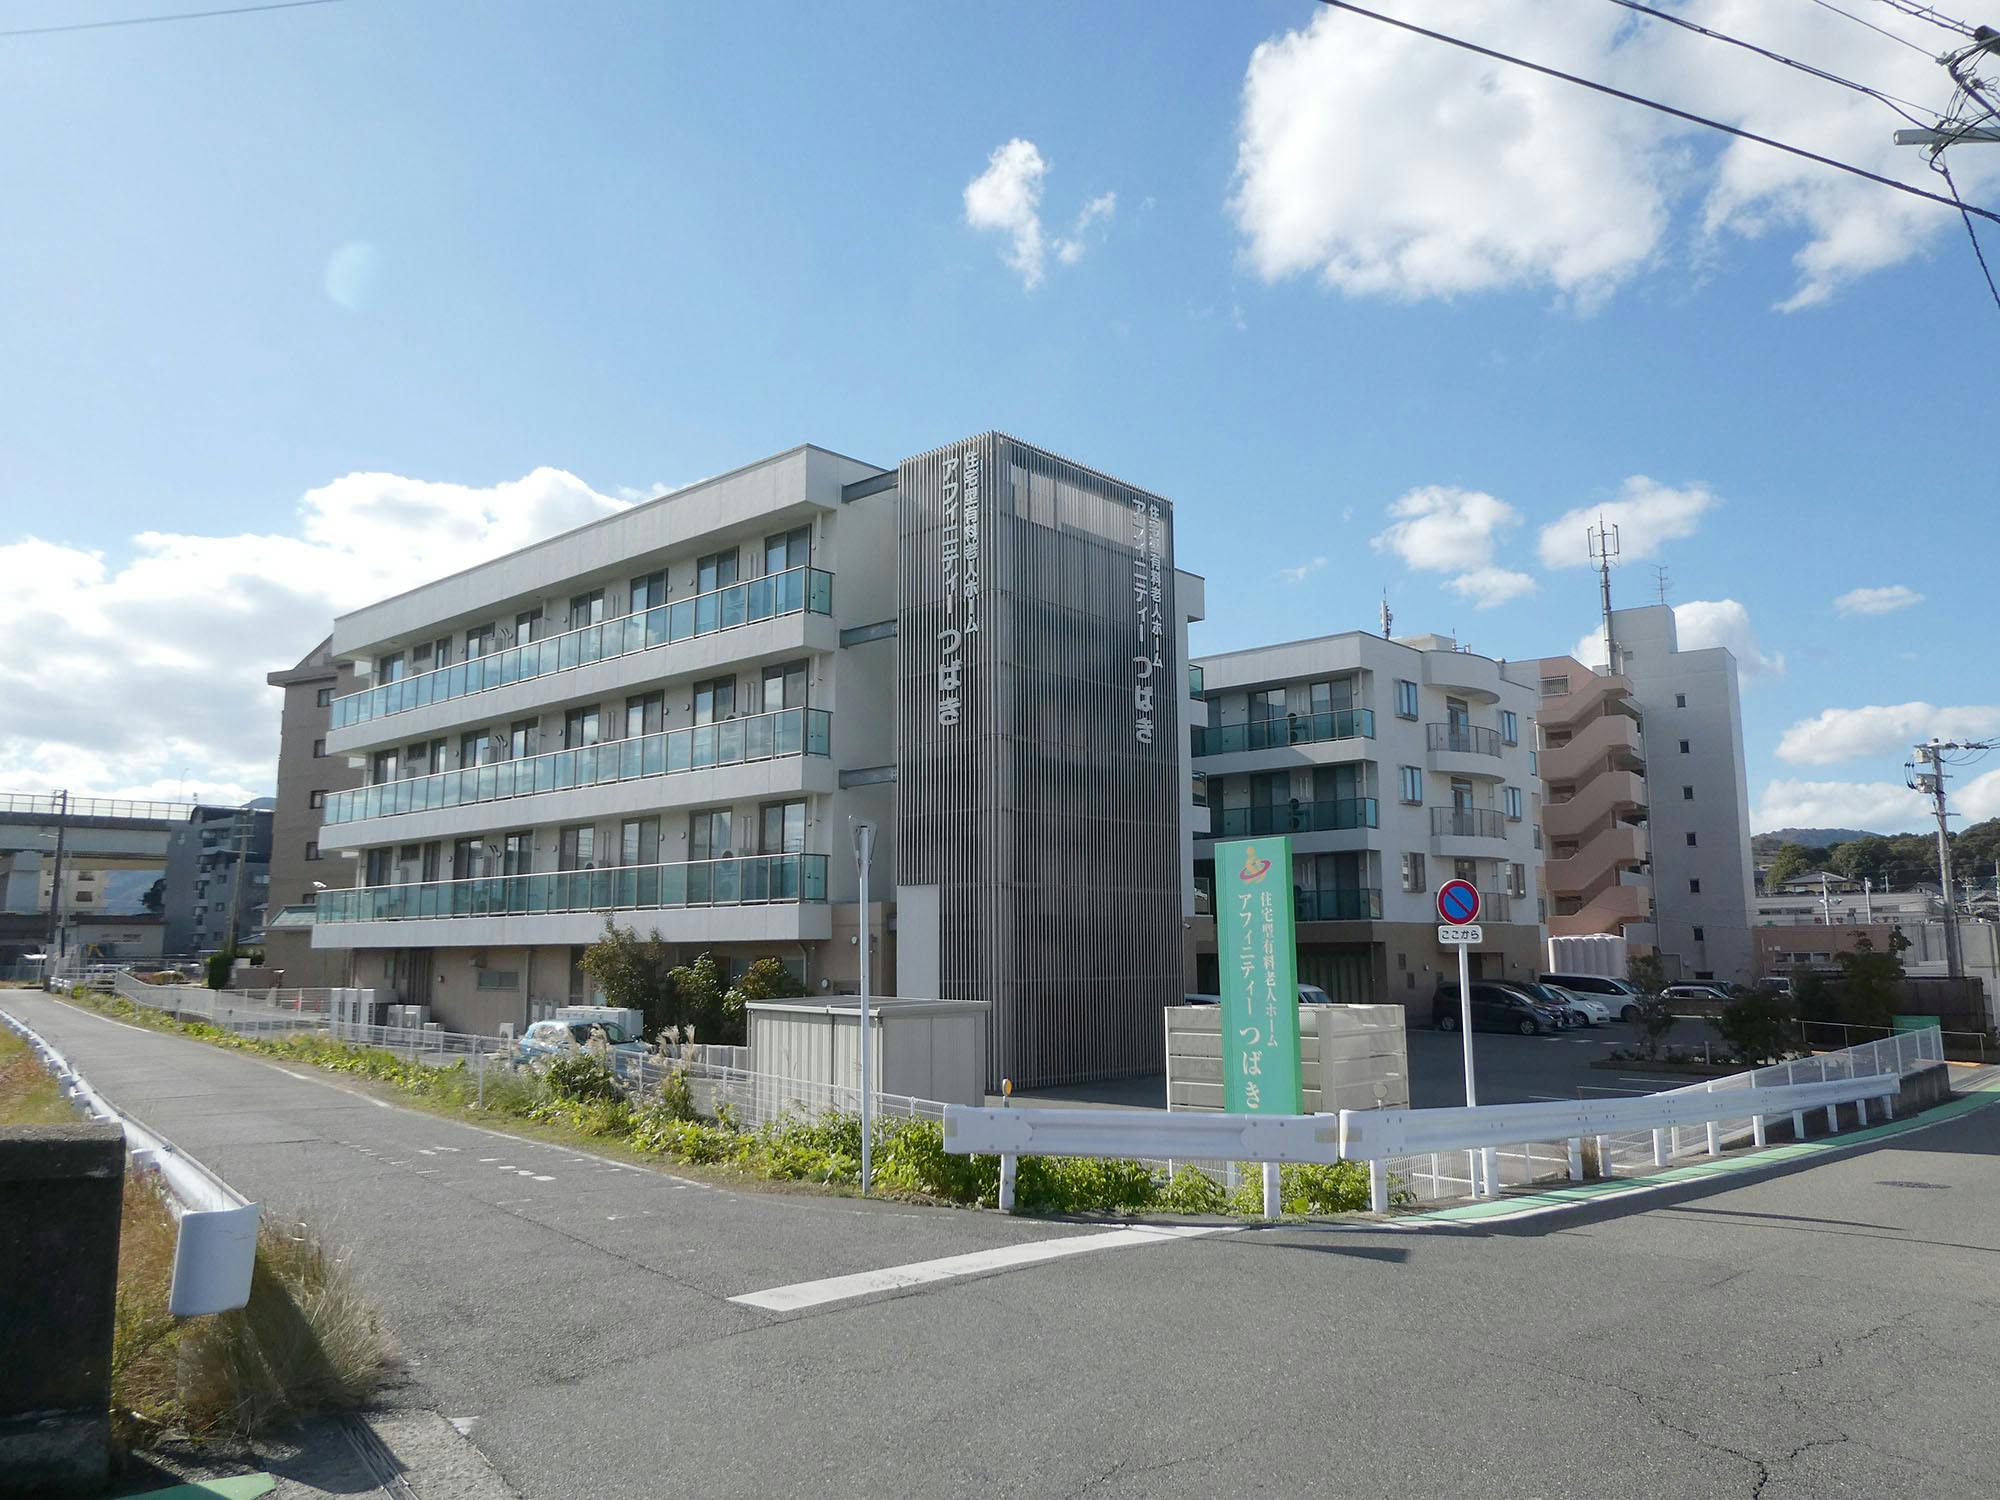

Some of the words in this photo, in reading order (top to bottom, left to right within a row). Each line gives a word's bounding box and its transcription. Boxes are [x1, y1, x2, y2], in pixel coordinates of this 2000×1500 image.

[1261, 891, 1278, 1047] 住宅型有料老人ホーム
[1441, 930, 1480, 940] ここから
